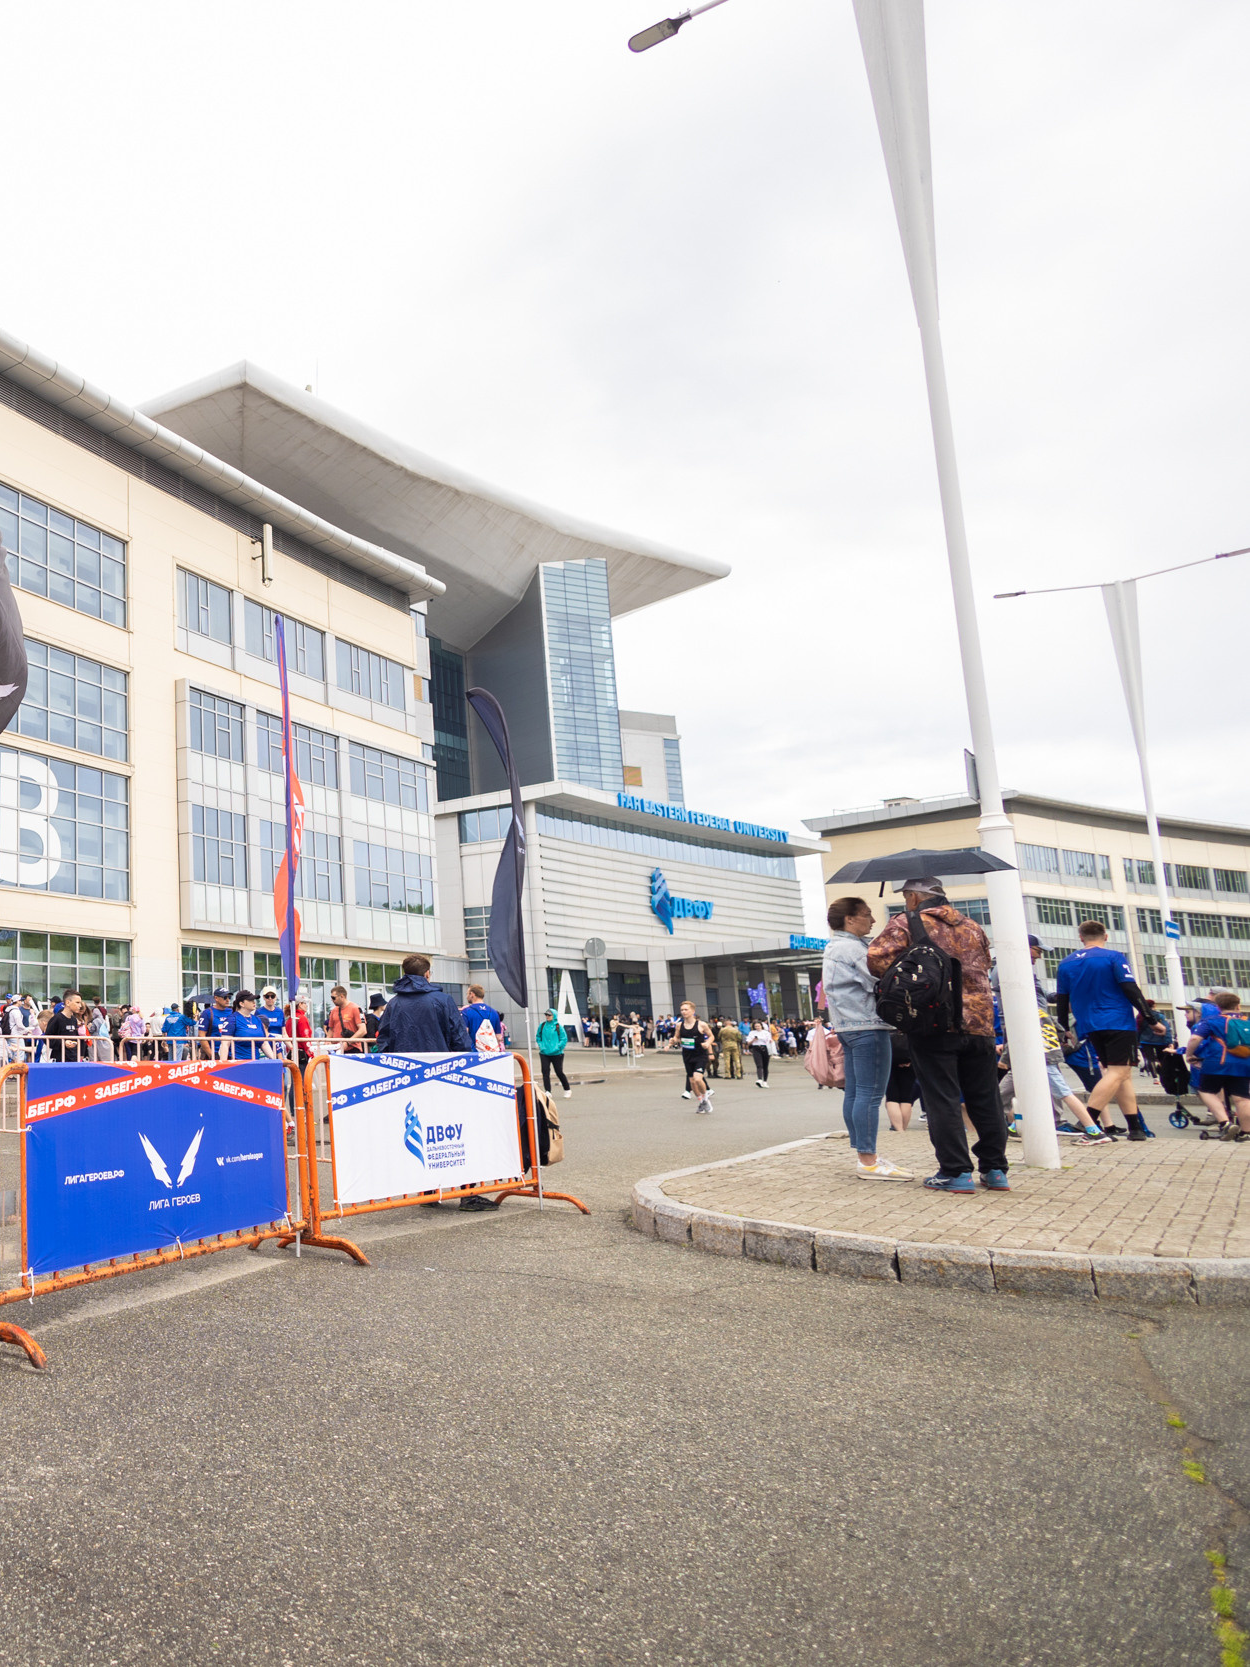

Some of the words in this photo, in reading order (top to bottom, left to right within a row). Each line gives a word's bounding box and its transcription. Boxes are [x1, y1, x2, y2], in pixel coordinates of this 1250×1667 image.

[618, 792, 642, 812] FAR
[641, 798, 688, 824] EASTERN
[688, 810, 733, 833] FEDERAL
[733, 820, 790, 844] UNIVERSITY
[670, 896, 714, 920] ДВФУ
[94, 1075, 153, 1100] ЗАБЕГ.РФ
[362, 1074, 411, 1098] ЗАБЕГ.РФ
[423, 1057, 467, 1079] ЗАБЕГ.РФ
[212, 1080, 254, 1099] ЗАБЕГ.РФ
[426, 1123, 463, 1145] ДВФУ
[427, 1150, 466, 1160] ФЕДЕРАЛЬНЫЙ
[428, 1158, 466, 1170] УНИВЕРСИТЕТ
[64, 1169, 125, 1185] ЛИГАГЕРОЕВ.РФ
[148, 1198, 170, 1211] ЛИГА
[171, 1193, 201, 1207] ГЕРОЕВ
